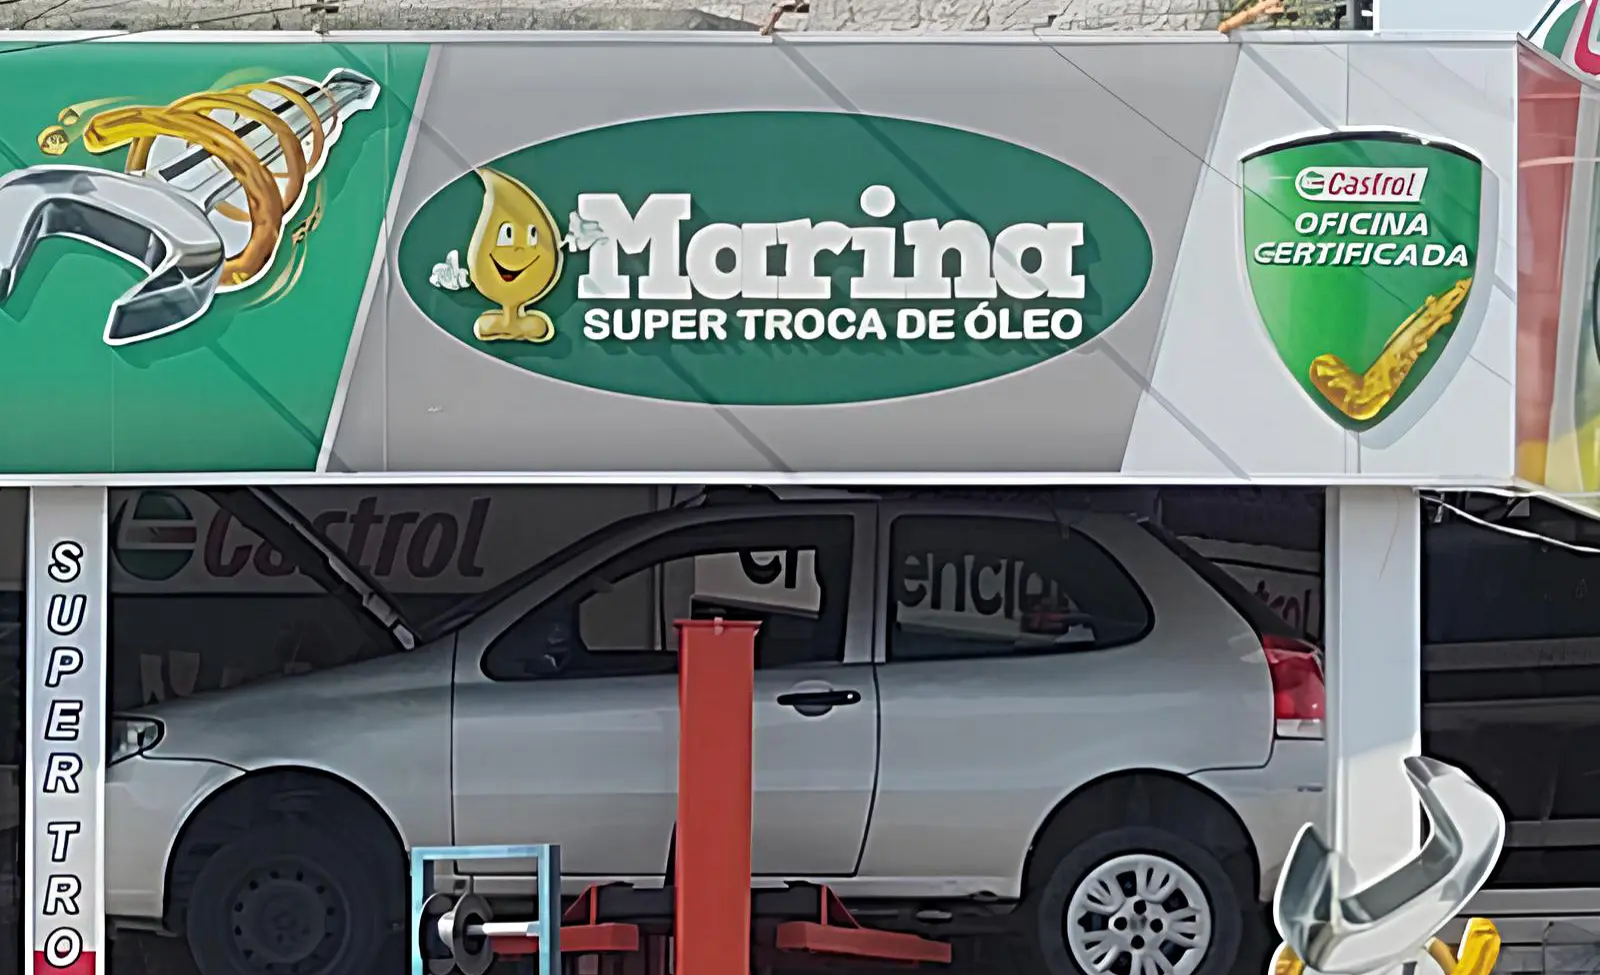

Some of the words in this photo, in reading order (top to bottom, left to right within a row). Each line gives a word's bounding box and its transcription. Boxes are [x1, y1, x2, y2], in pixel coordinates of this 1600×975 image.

[1328, 172, 1415, 196] Castrol
[1295, 212, 1428, 236] OFICINA
[578, 185, 1085, 300] Marina
[1254, 241, 1468, 267] CERTIFICADA
[583, 309, 727, 341] SUPER
[737, 309, 886, 341] TROCA
[897, 309, 955, 341] DE
[965, 303, 1083, 341] ÓLEO
[43, 540, 87, 794] SUPER
